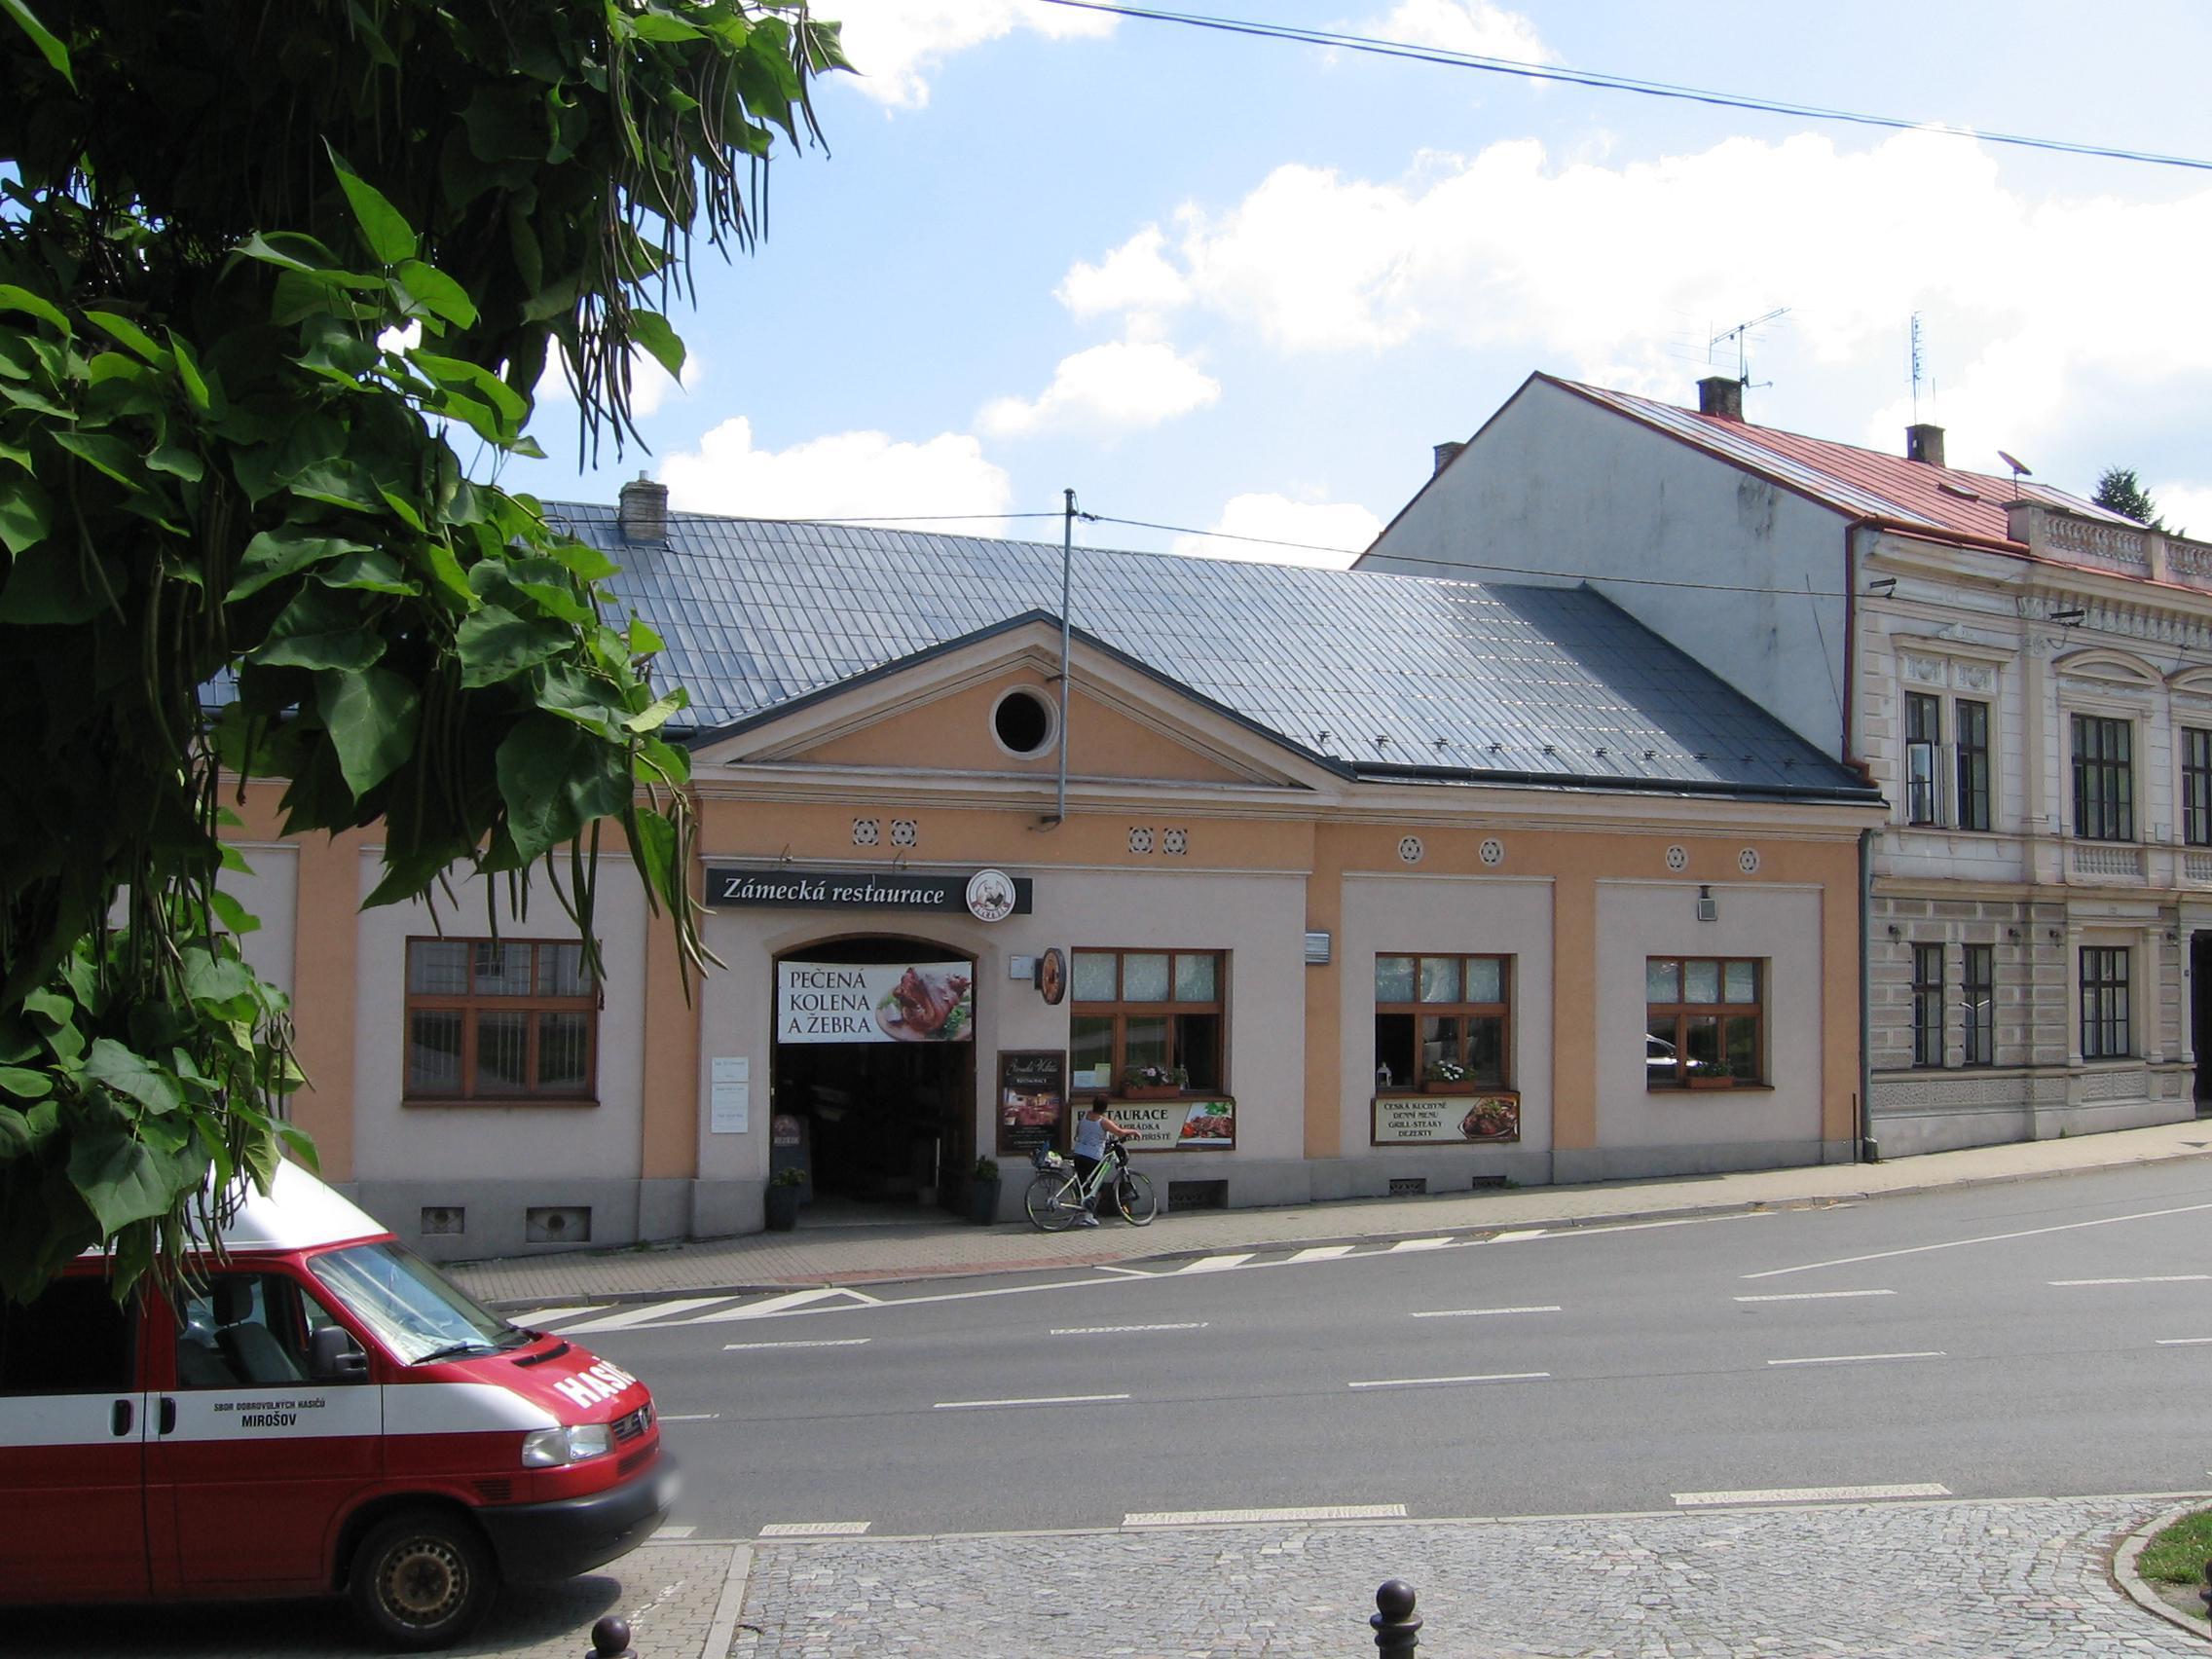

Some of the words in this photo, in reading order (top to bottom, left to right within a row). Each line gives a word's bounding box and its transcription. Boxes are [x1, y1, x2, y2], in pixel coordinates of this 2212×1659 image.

[723, 877, 826, 901] Zámecká
[831, 884, 944, 904] restaurace
[791, 968, 866, 988] PEČENÁ
[791, 994, 870, 1011] KOLENA
[788, 1017, 802, 1033] A
[807, 1014, 871, 1033] ŽEBRA
[1078, 1109, 1168, 1121] RTAURACE
[241, 1411, 296, 1427] MIROŠOV
